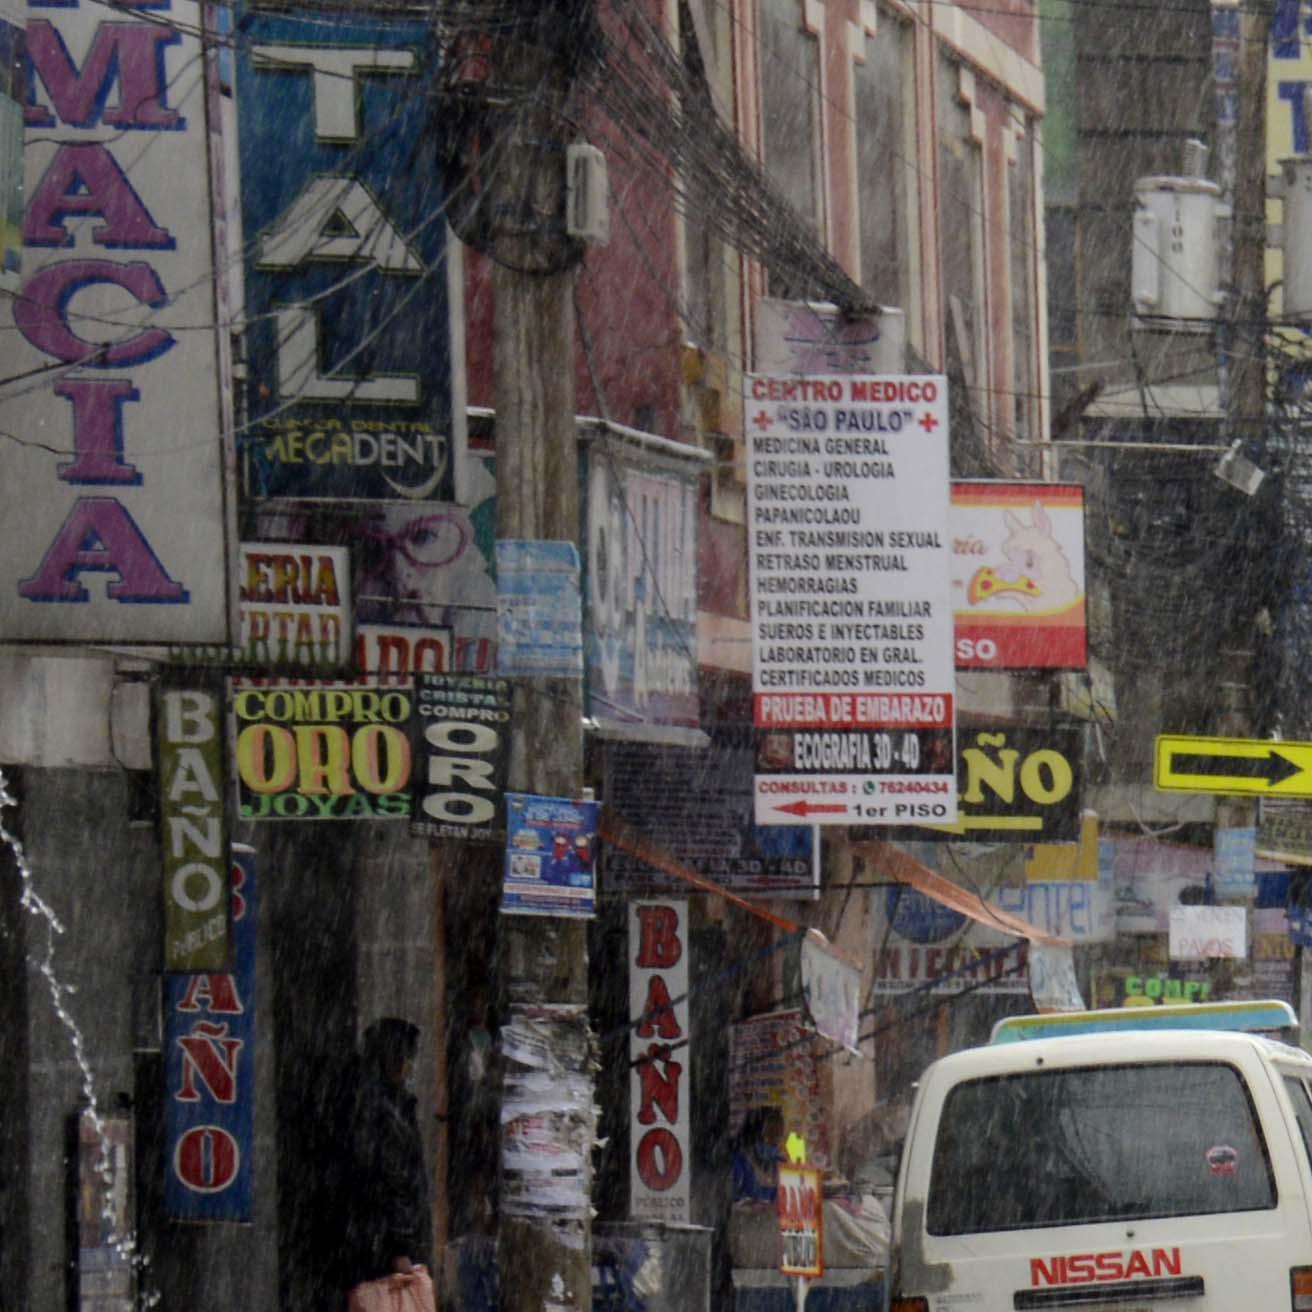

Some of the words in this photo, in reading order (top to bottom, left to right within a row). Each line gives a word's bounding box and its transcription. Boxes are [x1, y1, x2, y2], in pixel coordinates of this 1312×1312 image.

[14, 0, 190, 604] MACIA
[752, 379, 843, 402] CENTRO
[851, 381, 937, 403] MEDICO
[753, 437, 820, 454] MEDICINA
[825, 438, 888, 455] GENERAL
[753, 460, 811, 477] CIRUGIA
[823, 461, 896, 478] UROLOGIA
[754, 484, 849, 501] GINECOLOGIA
[755, 507, 860, 524] PAPANICOLAOU
[756, 530, 784, 547] ENF.
[789, 530, 884, 548] TRANSMISION
[889, 531, 941, 549] SEXUAL
[756, 554, 820, 571] RETRASO
[825, 554, 908, 572] MENSTRUAL
[241, 552, 340, 606] ERIA
[757, 577, 858, 594] HEMORRAGIAS
[758, 600, 863, 617] PLANIFICACION
[868, 601, 932, 618] FAMILIAR
[241, 610, 340, 666] RTAD
[758, 623, 813, 640] SUEROS
[818, 624, 826, 640] E
[831, 624, 925, 641] INYECTABLES
[760, 647, 856, 664] LABORATORIO
[860, 648, 878, 663] EN
[883, 648, 923, 664] GRAL.
[956, 642, 997, 661] SO
[760, 670, 859, 687] CERTIFICADOS
[863, 670, 925, 687] MEDICOS
[236, 690, 410, 723] COMPRO
[421, 689, 511, 706] CRISTA
[418, 704, 510, 722] COMPRO
[761, 696, 828, 721] PRUEBA
[831, 696, 852, 721] DE
[856, 696, 945, 722] EMBARAZO
[236, 723, 413, 796] ORO
[794, 733, 871, 768] ECOGRAFIA
[873, 733, 891, 768] 3D
[902, 733, 920, 768] 4D
[423, 721, 498, 824] ORO
[957, 733, 1073, 806] ÑO
[759, 781, 848, 794] CONSULTAS
[164, 690, 222, 912] BAÑO
[241, 793, 413, 818] JOYAS
[853, 804, 887, 817] 1er
[895, 804, 947, 817] PISO
[174, 858, 248, 1194] AÑO
[637, 904, 683, 1191] BAÑO
[1030, 1246, 1183, 1287] NISSAN
